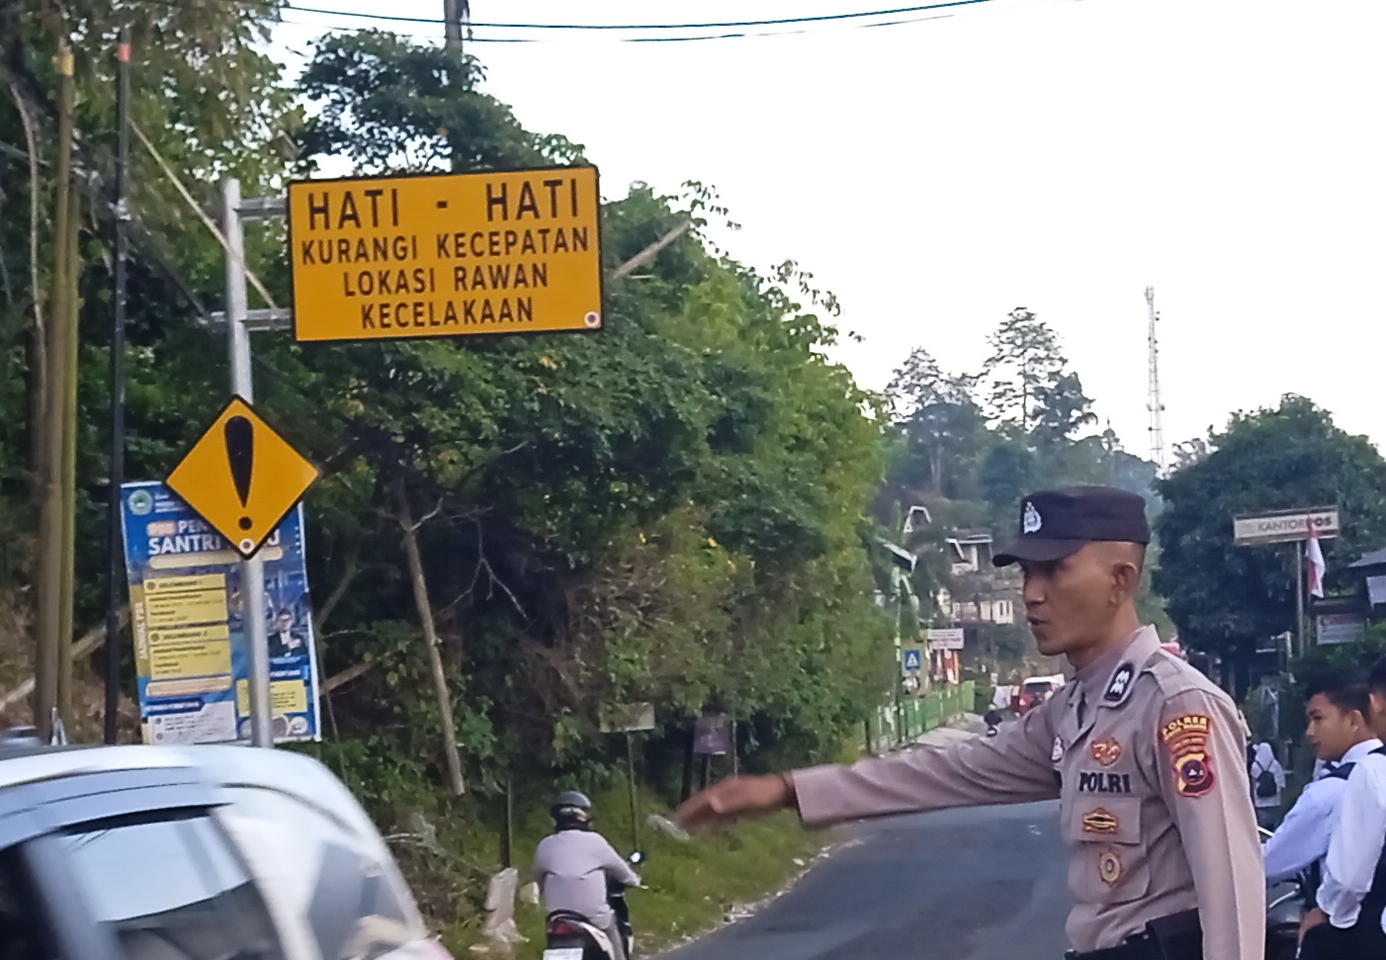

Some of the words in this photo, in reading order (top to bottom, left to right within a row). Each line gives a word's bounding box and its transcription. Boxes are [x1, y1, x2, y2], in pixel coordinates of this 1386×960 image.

[308, 188, 400, 231] HATI
[436, 200, 448, 209] -
[486, 178, 579, 222] HATI
[302, 235, 417, 265] KURANGI
[436, 227, 589, 259] KECEPATAN
[343, 267, 435, 297] LOKASI
[454, 262, 548, 291] RAWAN
[362, 297, 533, 329] KECELAKAAN
[1258, 519, 1305, 531] KANTOR
[1307, 516, 1332, 527] OS
[148, 534, 222, 555] SANTRI
[1079, 772, 1131, 793] POLRI
